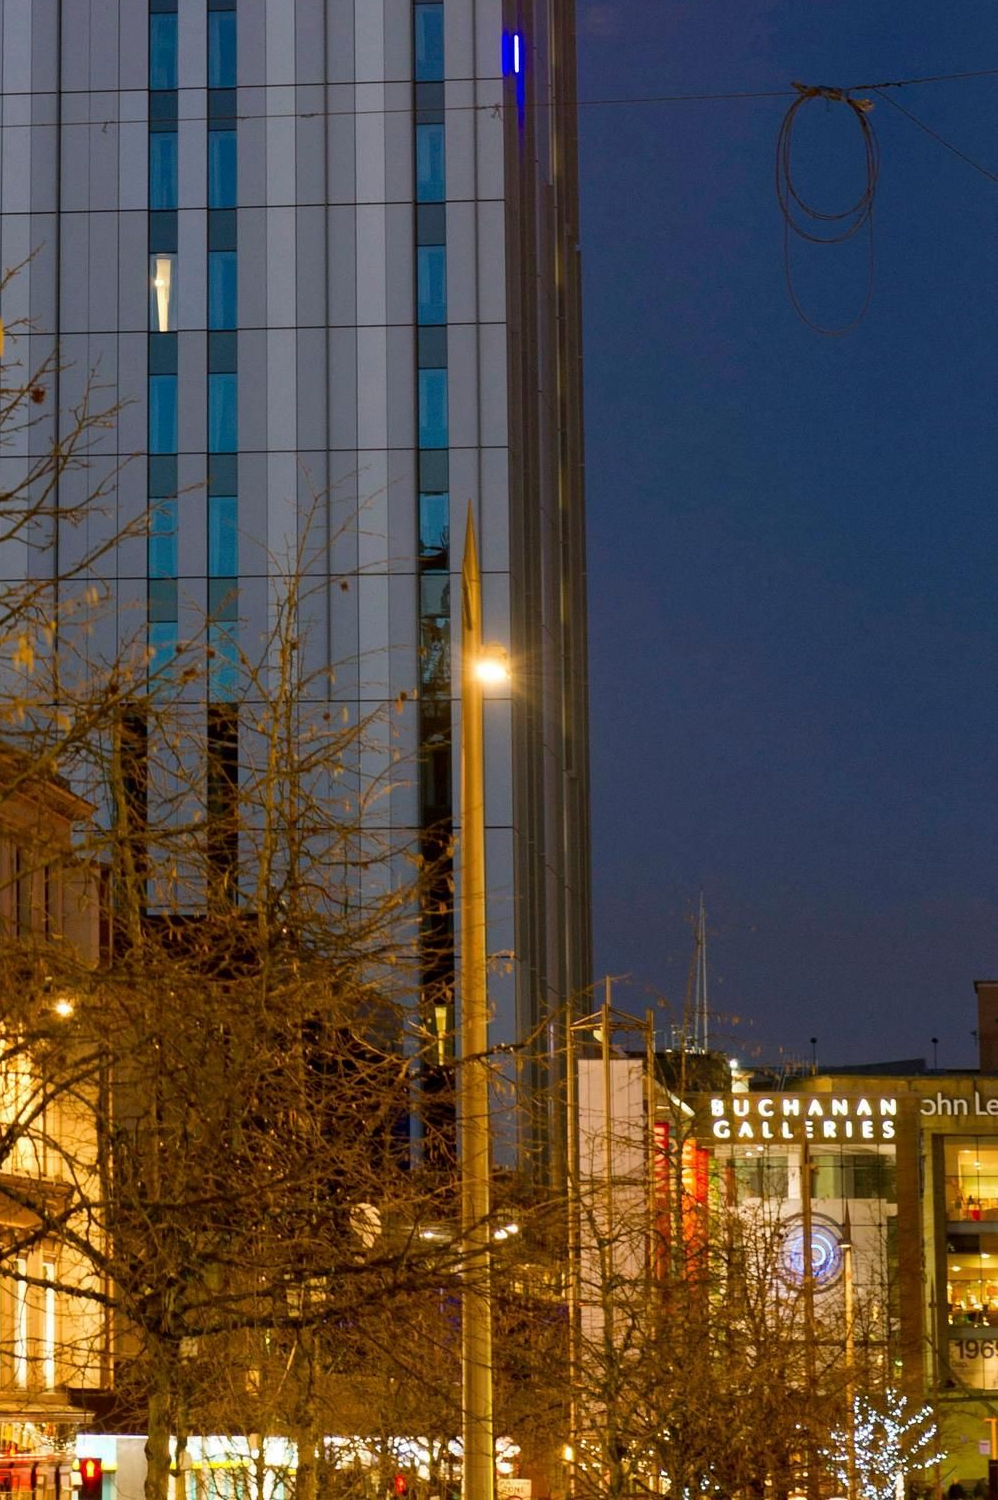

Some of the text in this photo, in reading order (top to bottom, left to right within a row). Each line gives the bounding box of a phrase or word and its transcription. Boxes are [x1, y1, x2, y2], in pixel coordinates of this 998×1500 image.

[710, 1098, 898, 1118] BUCHANAN
[920, 1092, 968, 1116] ohn
[712, 1119, 896, 1140] GALLERIES
